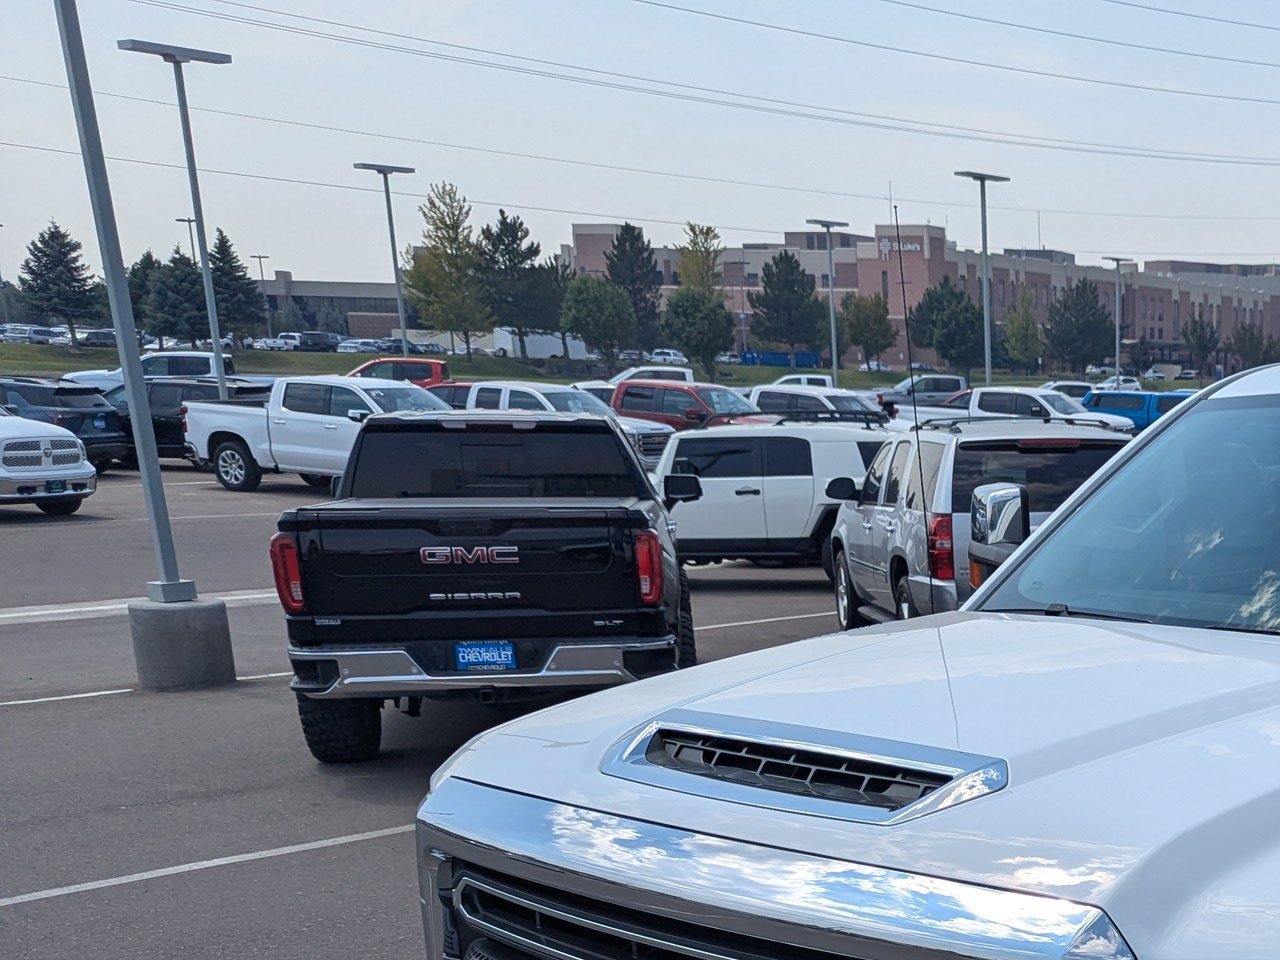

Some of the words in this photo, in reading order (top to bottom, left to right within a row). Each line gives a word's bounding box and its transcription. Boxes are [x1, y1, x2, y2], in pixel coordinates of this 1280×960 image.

[420, 546, 520, 564] GMC
[429, 592, 521, 600] SIERRA
[459, 651, 513, 663] CHEVROLET
